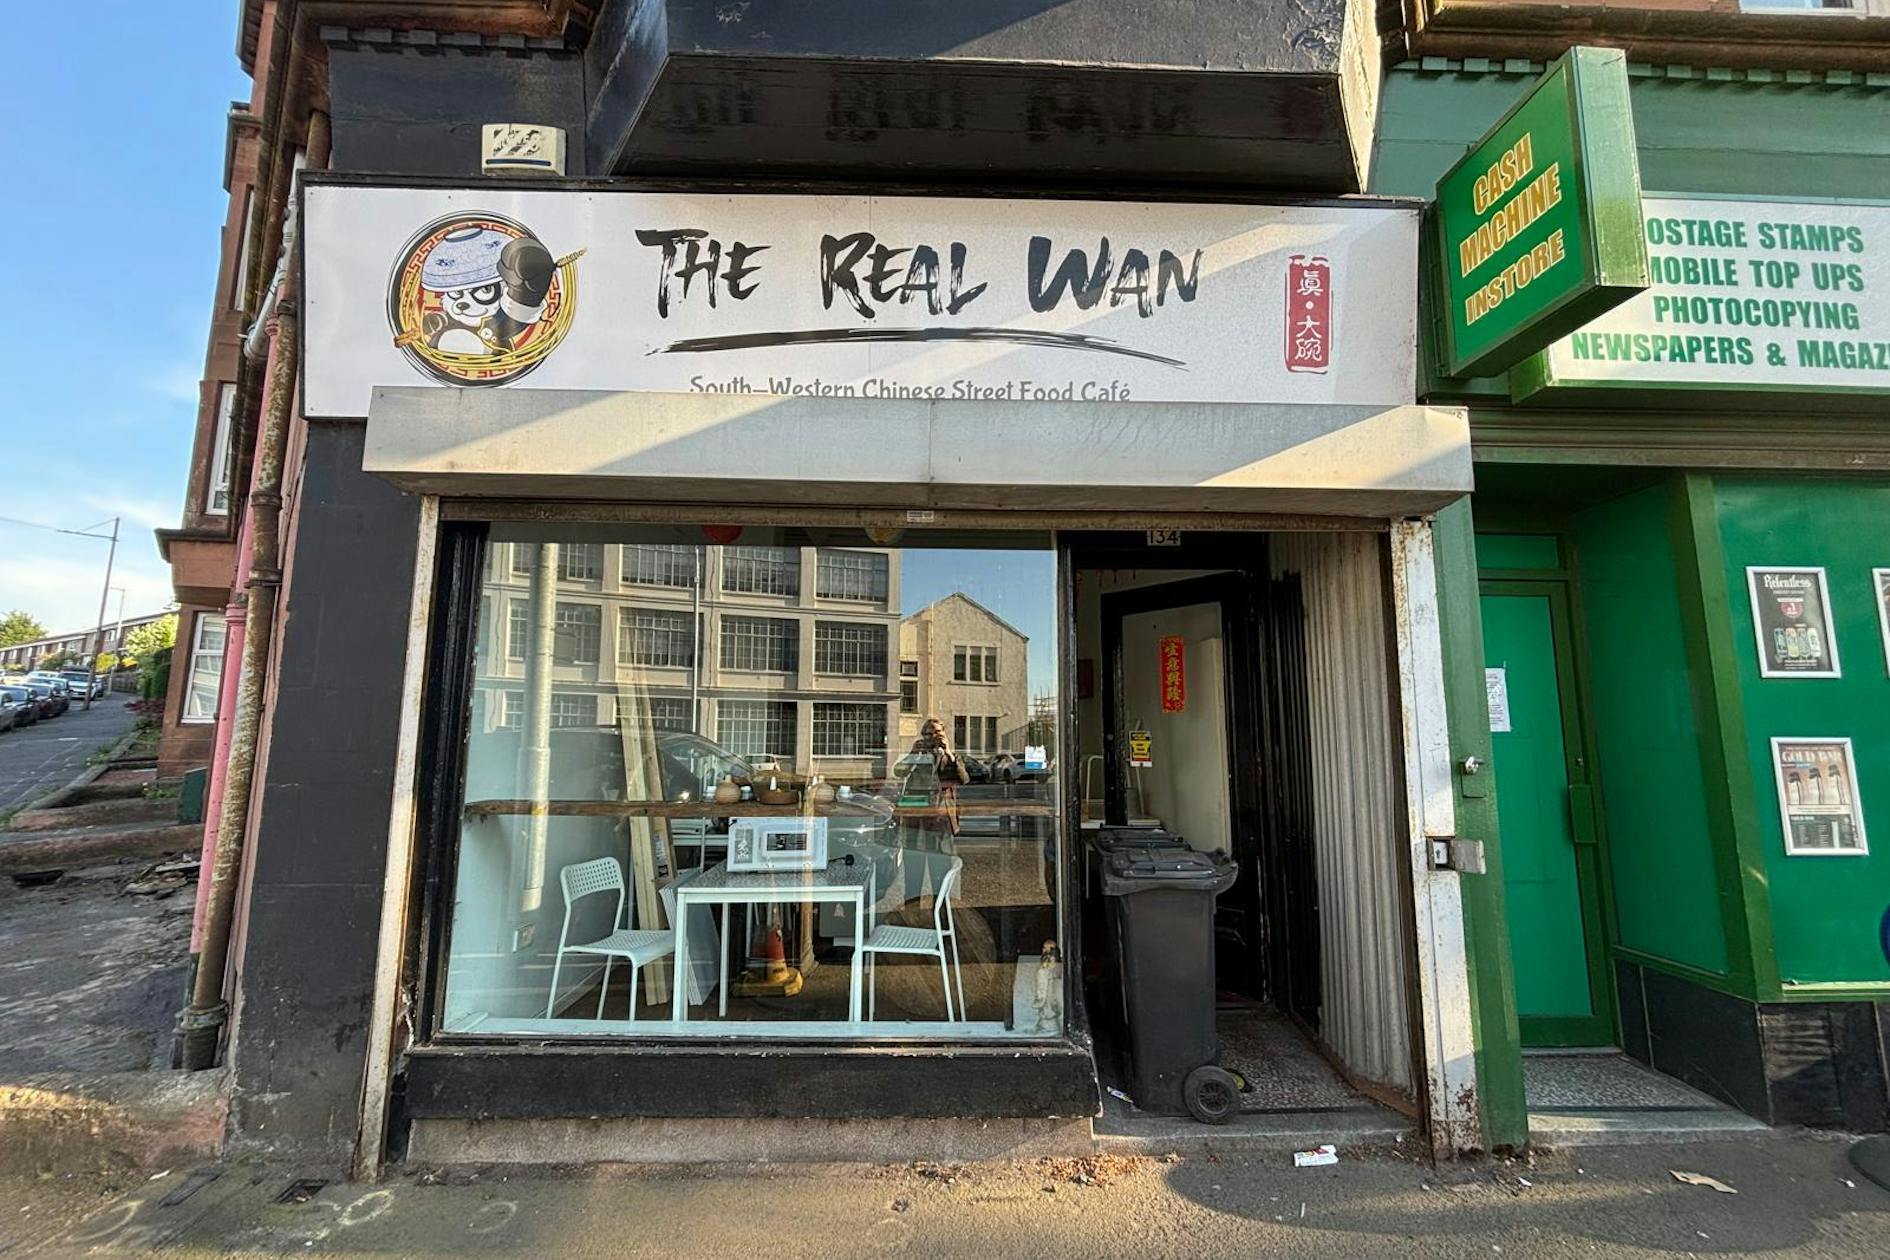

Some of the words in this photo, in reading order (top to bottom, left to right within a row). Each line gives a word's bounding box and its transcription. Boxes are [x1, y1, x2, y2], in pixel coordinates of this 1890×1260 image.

[1473, 132, 1533, 216] CASH
[1460, 162, 1562, 278] MACHINE
[1646, 217, 1748, 248] OSTAGE
[1757, 222, 1864, 253] STAMPS
[635, 228, 771, 319] THE
[820, 231, 988, 320] REAL
[1027, 235, 1203, 318] WAN
[1465, 228, 1565, 326] INSTORE
[1748, 259, 1800, 290] TOP
[1811, 262, 1865, 292] UPS
[1653, 295, 1861, 331] PHOTOCOPYING
[1571, 332, 1755, 366] NEWSPAPERS
[1766, 342, 1787, 367] &
[1796, 339, 1890, 370] MAGAZ
[862, 378, 945, 399] Chinese
[952, 379, 1014, 400] Street
[1020, 381, 1073, 401] Food
[1080, 379, 1131, 401] Café
[1150, 530, 1179, 544] 134
